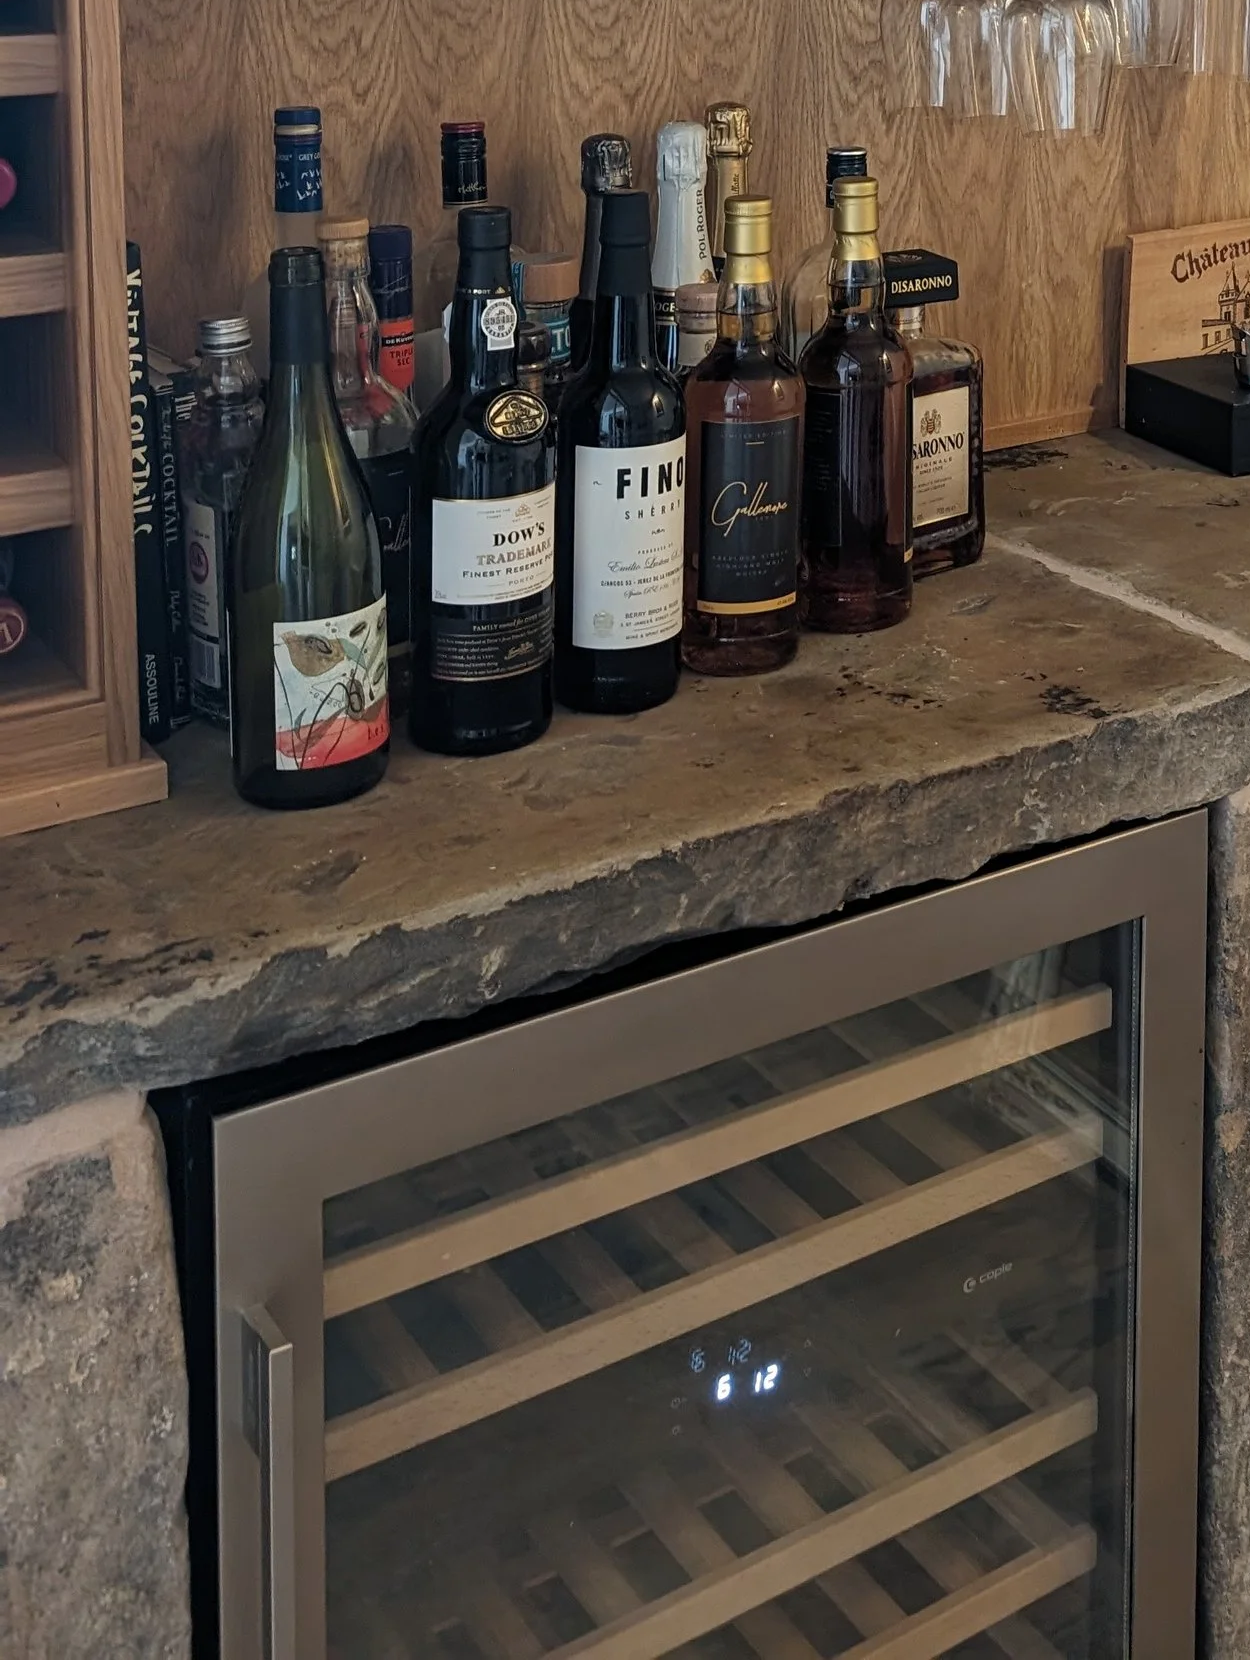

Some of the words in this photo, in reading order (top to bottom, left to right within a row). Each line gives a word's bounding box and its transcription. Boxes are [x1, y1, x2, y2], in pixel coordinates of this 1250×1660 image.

[698, 234, 707, 260] POL
[890, 274, 953, 295] DISARONNO
[397, 357, 410, 366] SEC
[616, 455, 684, 500] FINO
[160, 453, 178, 547] COCKTAIL
[493, 521, 545, 547] DOW'S
[508, 575, 535, 586] PORTO
[473, 623, 498, 632] FAMILY
[145, 653, 159, 725] ASSOULINE
[718, 1374, 731, 1400] 6
[755, 1363, 779, 1394] 12
